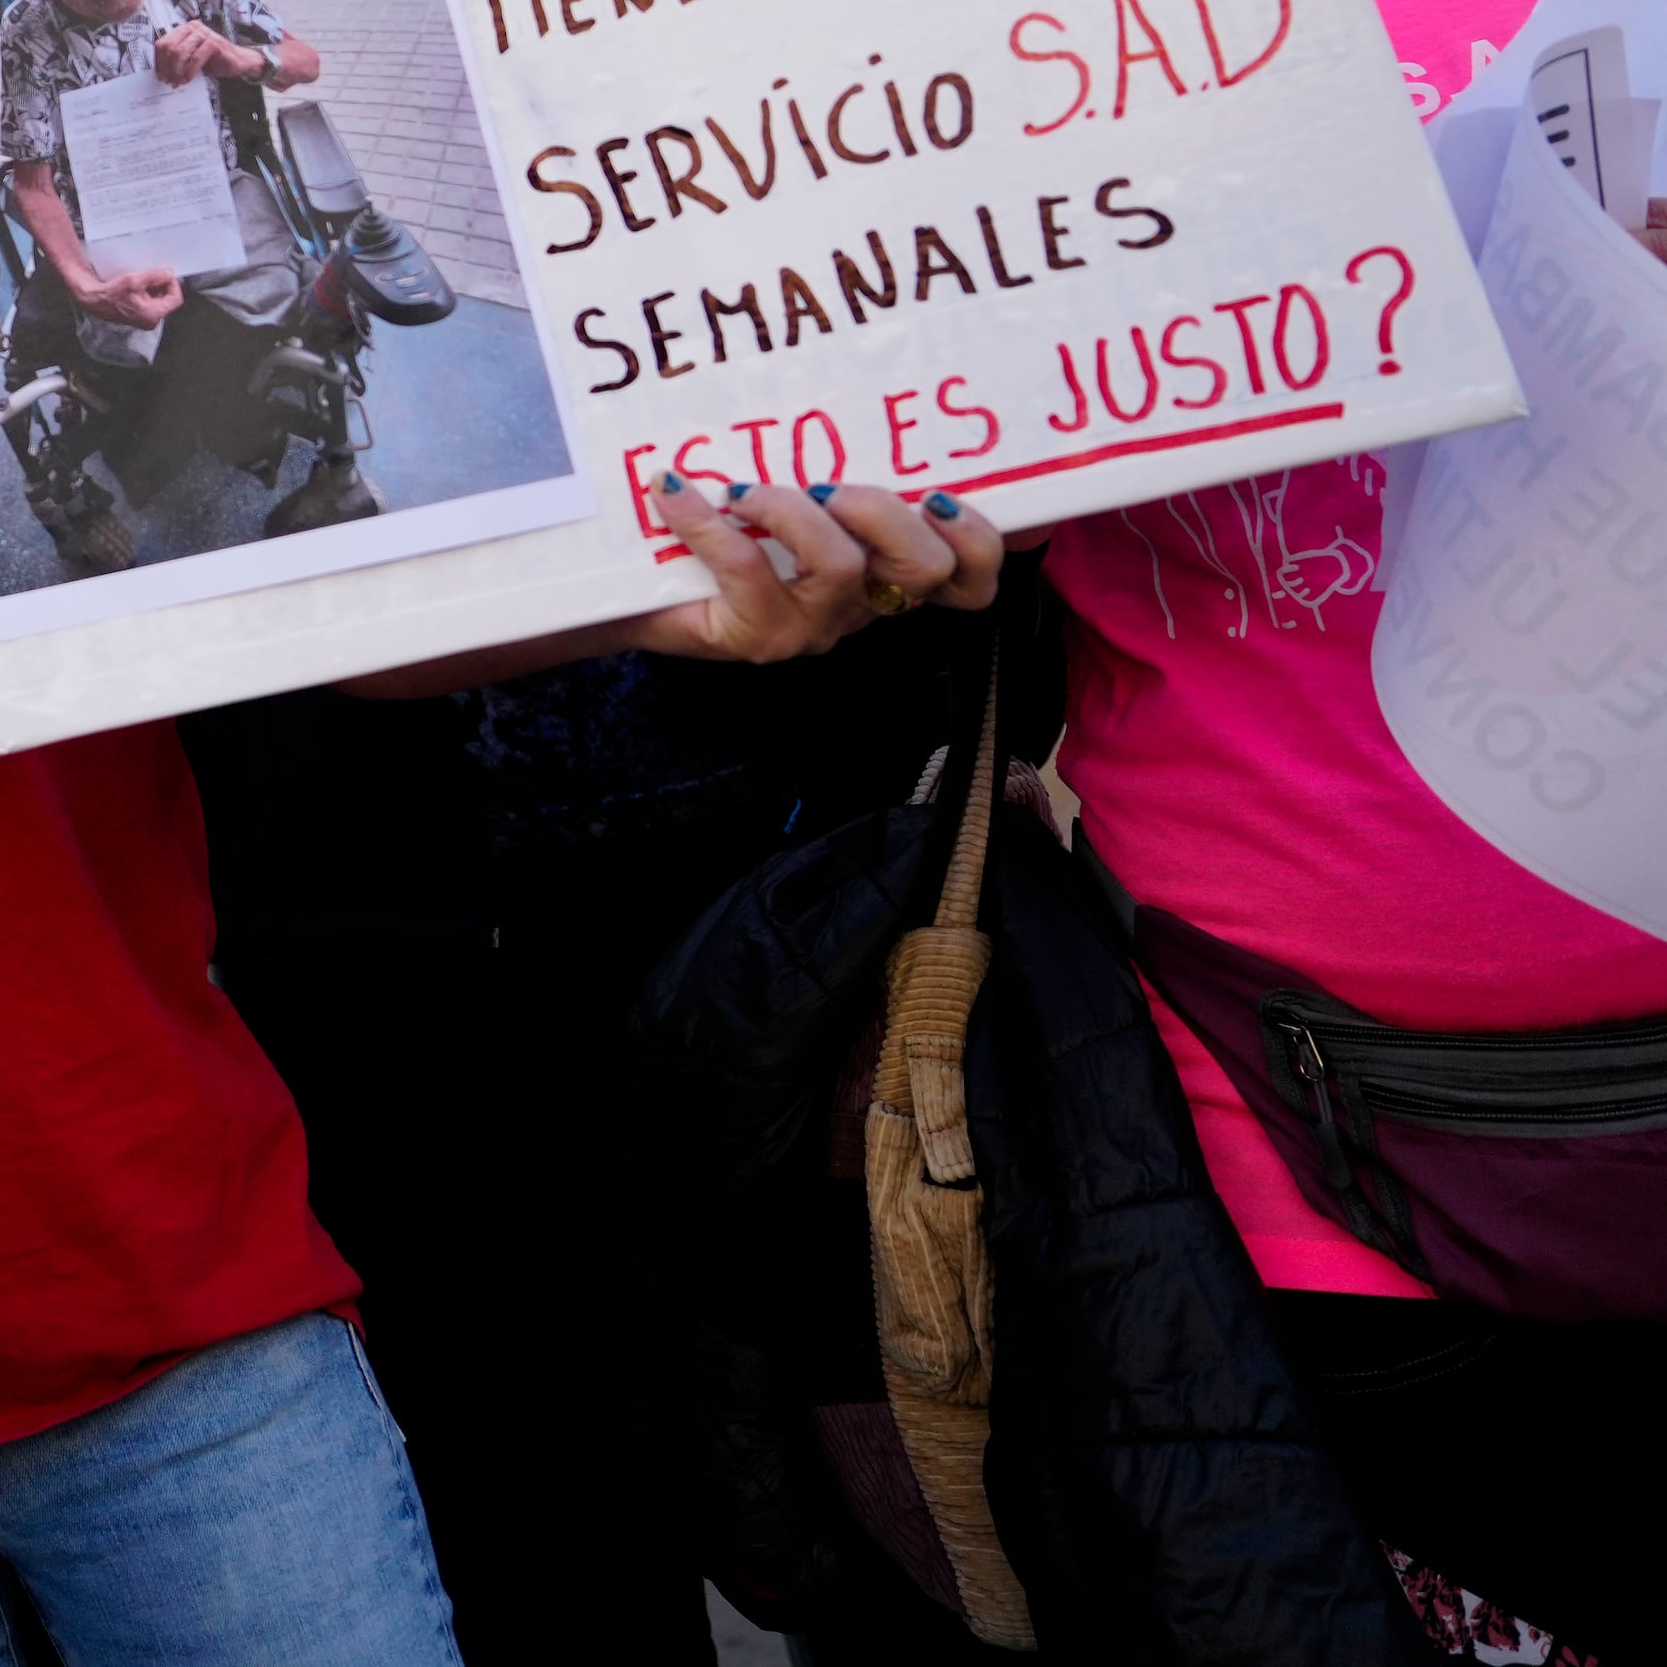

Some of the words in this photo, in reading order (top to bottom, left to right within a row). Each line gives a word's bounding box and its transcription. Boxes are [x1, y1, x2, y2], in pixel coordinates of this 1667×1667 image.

[573, 176, 1176, 394] SEMANALES
[623, 409, 847, 540] ESTO
[882, 375, 1001, 476] ES
